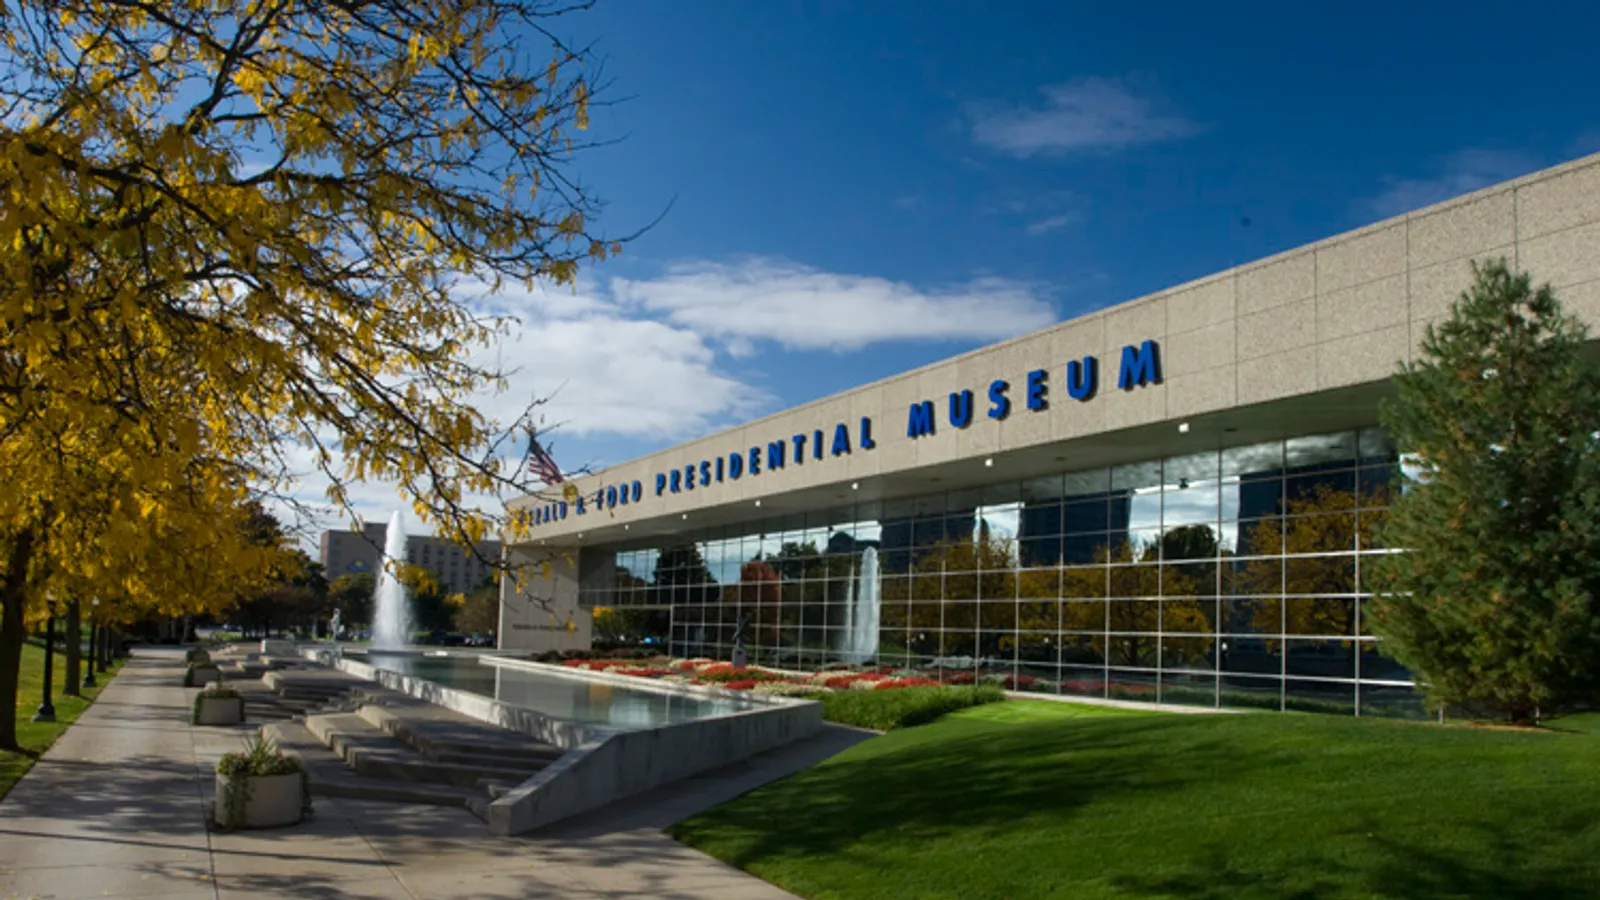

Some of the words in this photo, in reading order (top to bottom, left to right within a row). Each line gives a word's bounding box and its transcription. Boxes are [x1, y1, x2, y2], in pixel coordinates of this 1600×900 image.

[518, 501, 568, 529] ERALD
[596, 479, 642, 511] FORD
[655, 416, 876, 497] PRESIDENTIAL
[906, 339, 1164, 440] MUSEUM
